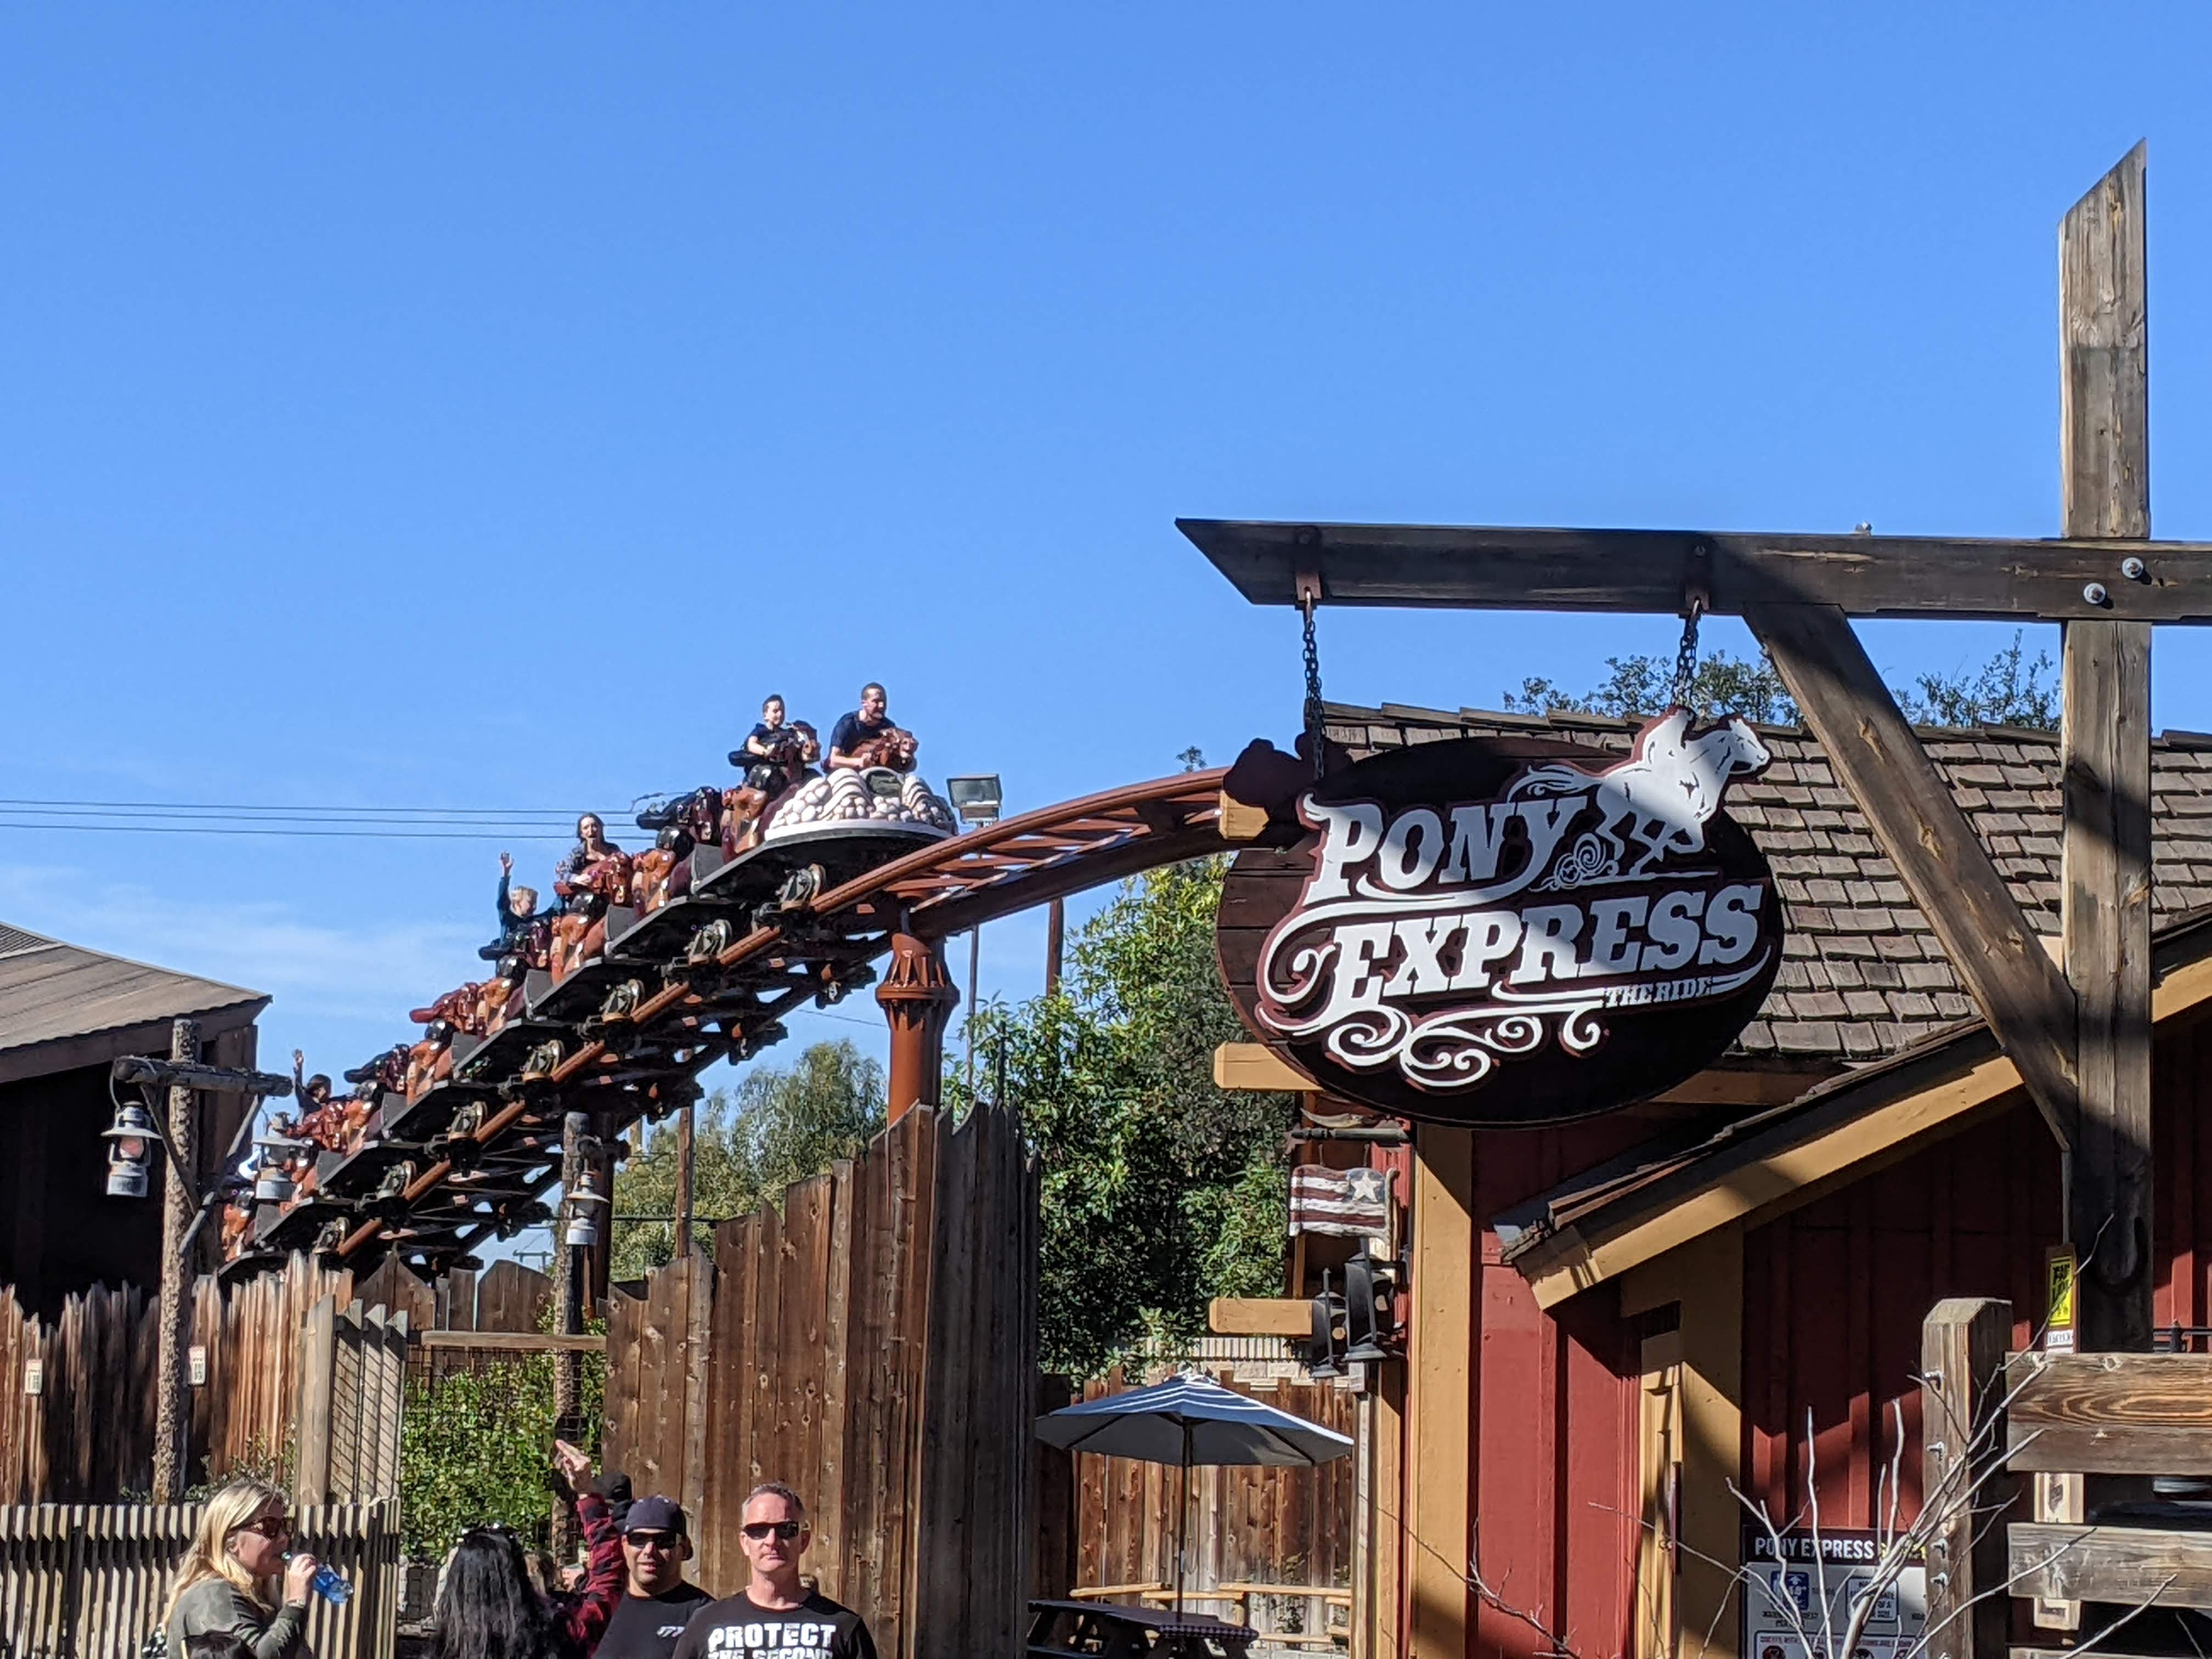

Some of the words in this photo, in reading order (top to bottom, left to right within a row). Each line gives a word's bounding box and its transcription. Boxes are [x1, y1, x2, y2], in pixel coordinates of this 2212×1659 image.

[1302, 793, 1587, 905] PONY
[1325, 884, 1764, 1011] EXPRESS
[1605, 984, 1654, 1008] THE
[1653, 977, 1712, 1003] RIDE
[1801, 1538, 1875, 1559] EXPRESS
[708, 1622, 836, 1652] PROTECT
